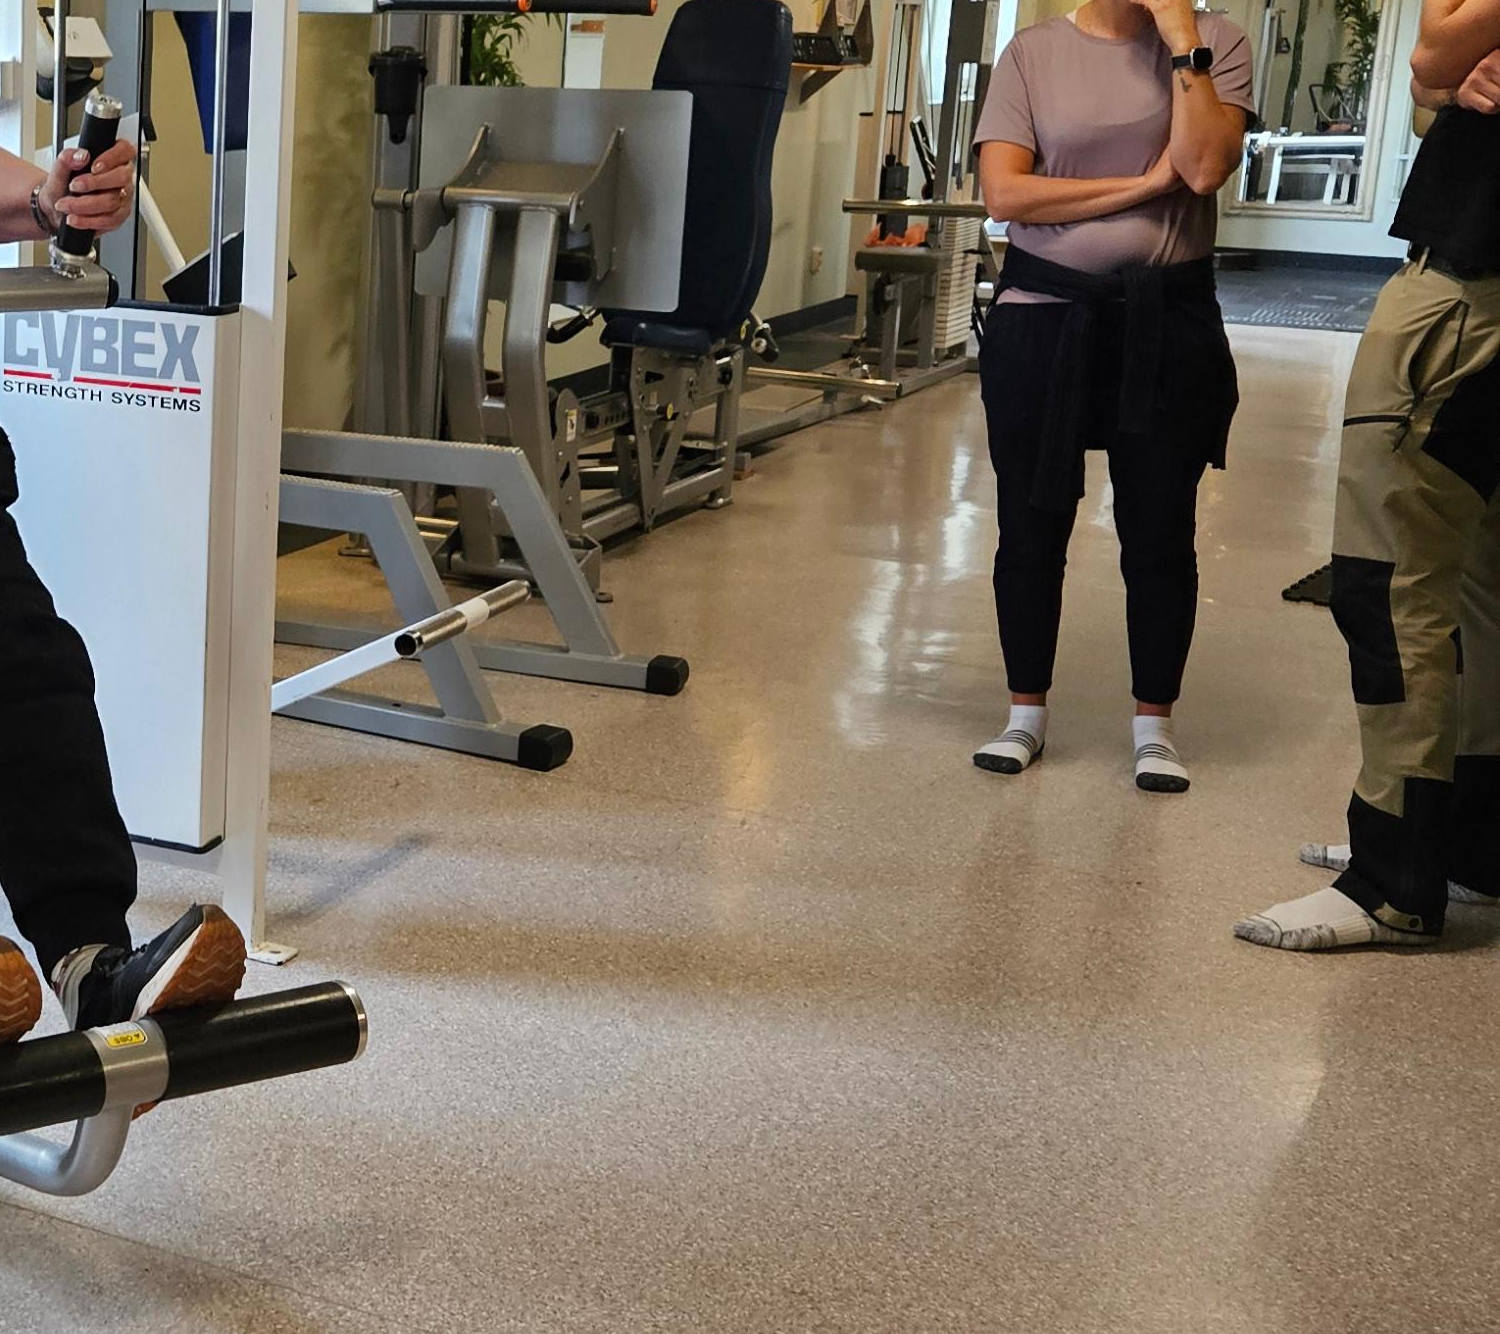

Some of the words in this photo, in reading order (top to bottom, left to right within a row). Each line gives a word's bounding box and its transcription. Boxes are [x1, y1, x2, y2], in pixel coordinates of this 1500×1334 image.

[4, 311, 201, 383] CYBEX
[3, 379, 102, 402] STRENGTH
[111, 391, 201, 412] SYSTEMS
